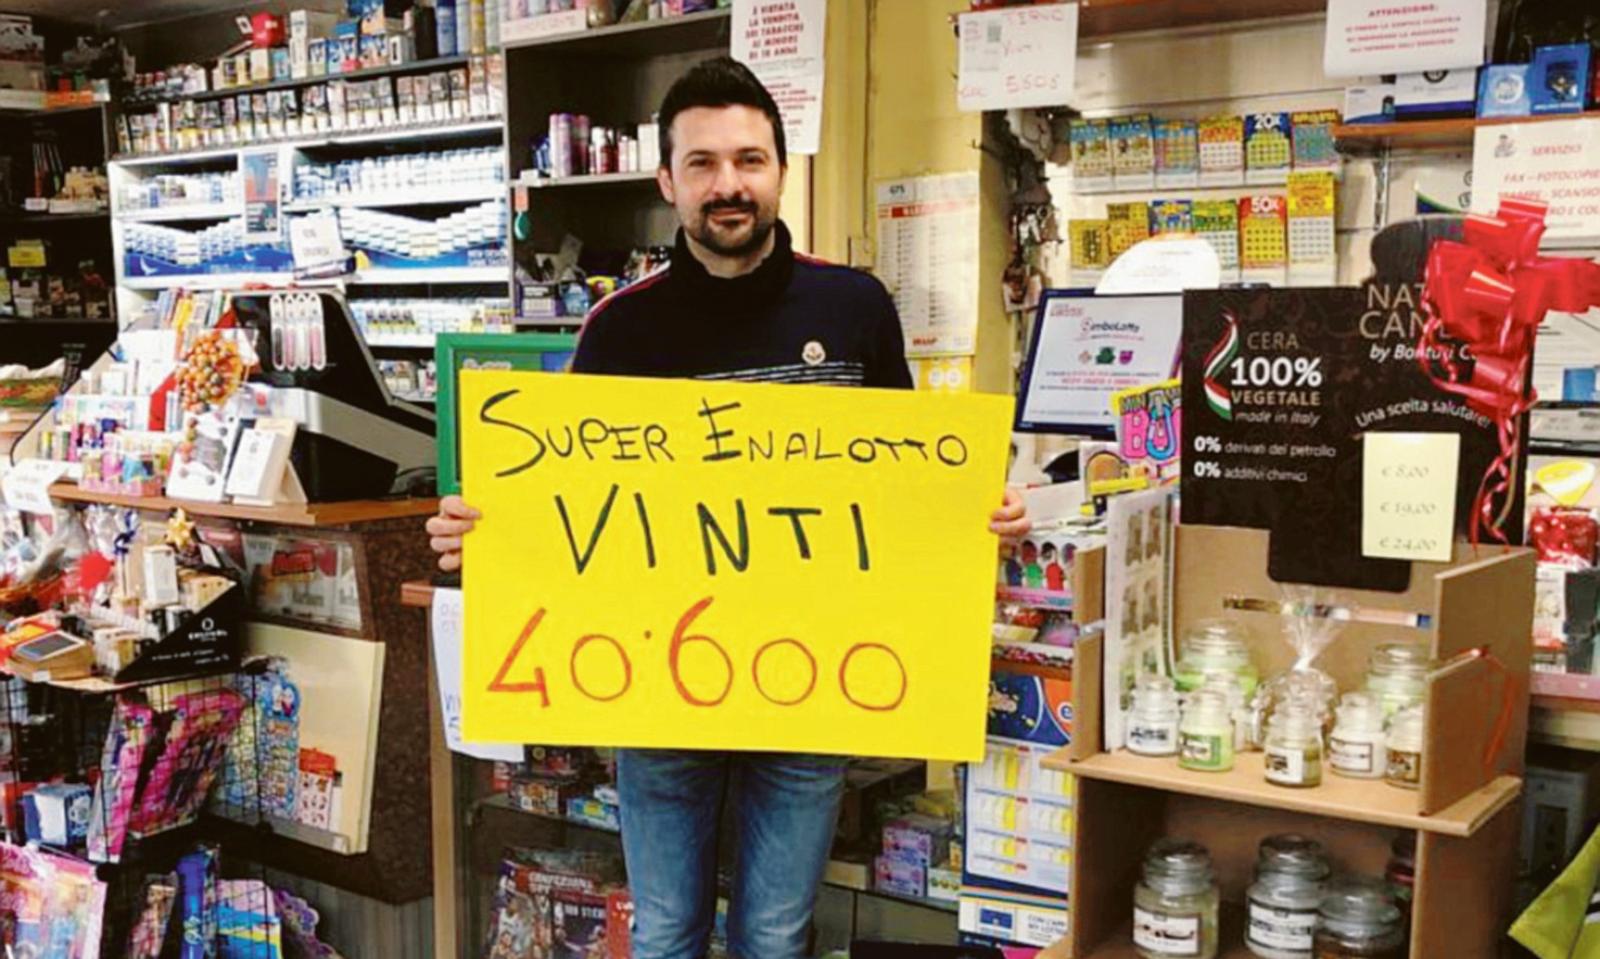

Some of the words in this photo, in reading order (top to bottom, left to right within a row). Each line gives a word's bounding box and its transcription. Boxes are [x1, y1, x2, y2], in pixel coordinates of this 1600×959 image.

[1247, 331, 1300, 350] CERA
[1370, 344, 1392, 363] by
[1231, 356, 1323, 386] 100%
[1231, 390, 1321, 406] VEGETALE
[1235, 411, 1272, 423] made
[1275, 411, 1287, 423] in
[1290, 411, 1321, 427] Italy
[1355, 408, 1385, 428] Una
[1387, 398, 1429, 417] scelta
[480, 389, 675, 478] SUPER
[697, 397, 968, 467] ENALOTTO
[1194, 436, 1222, 454] 0%
[1224, 441, 1267, 456] derivati
[1290, 443, 1337, 458] petrolio
[1193, 461, 1222, 479] 0%
[554, 484, 870, 576] VINTI
